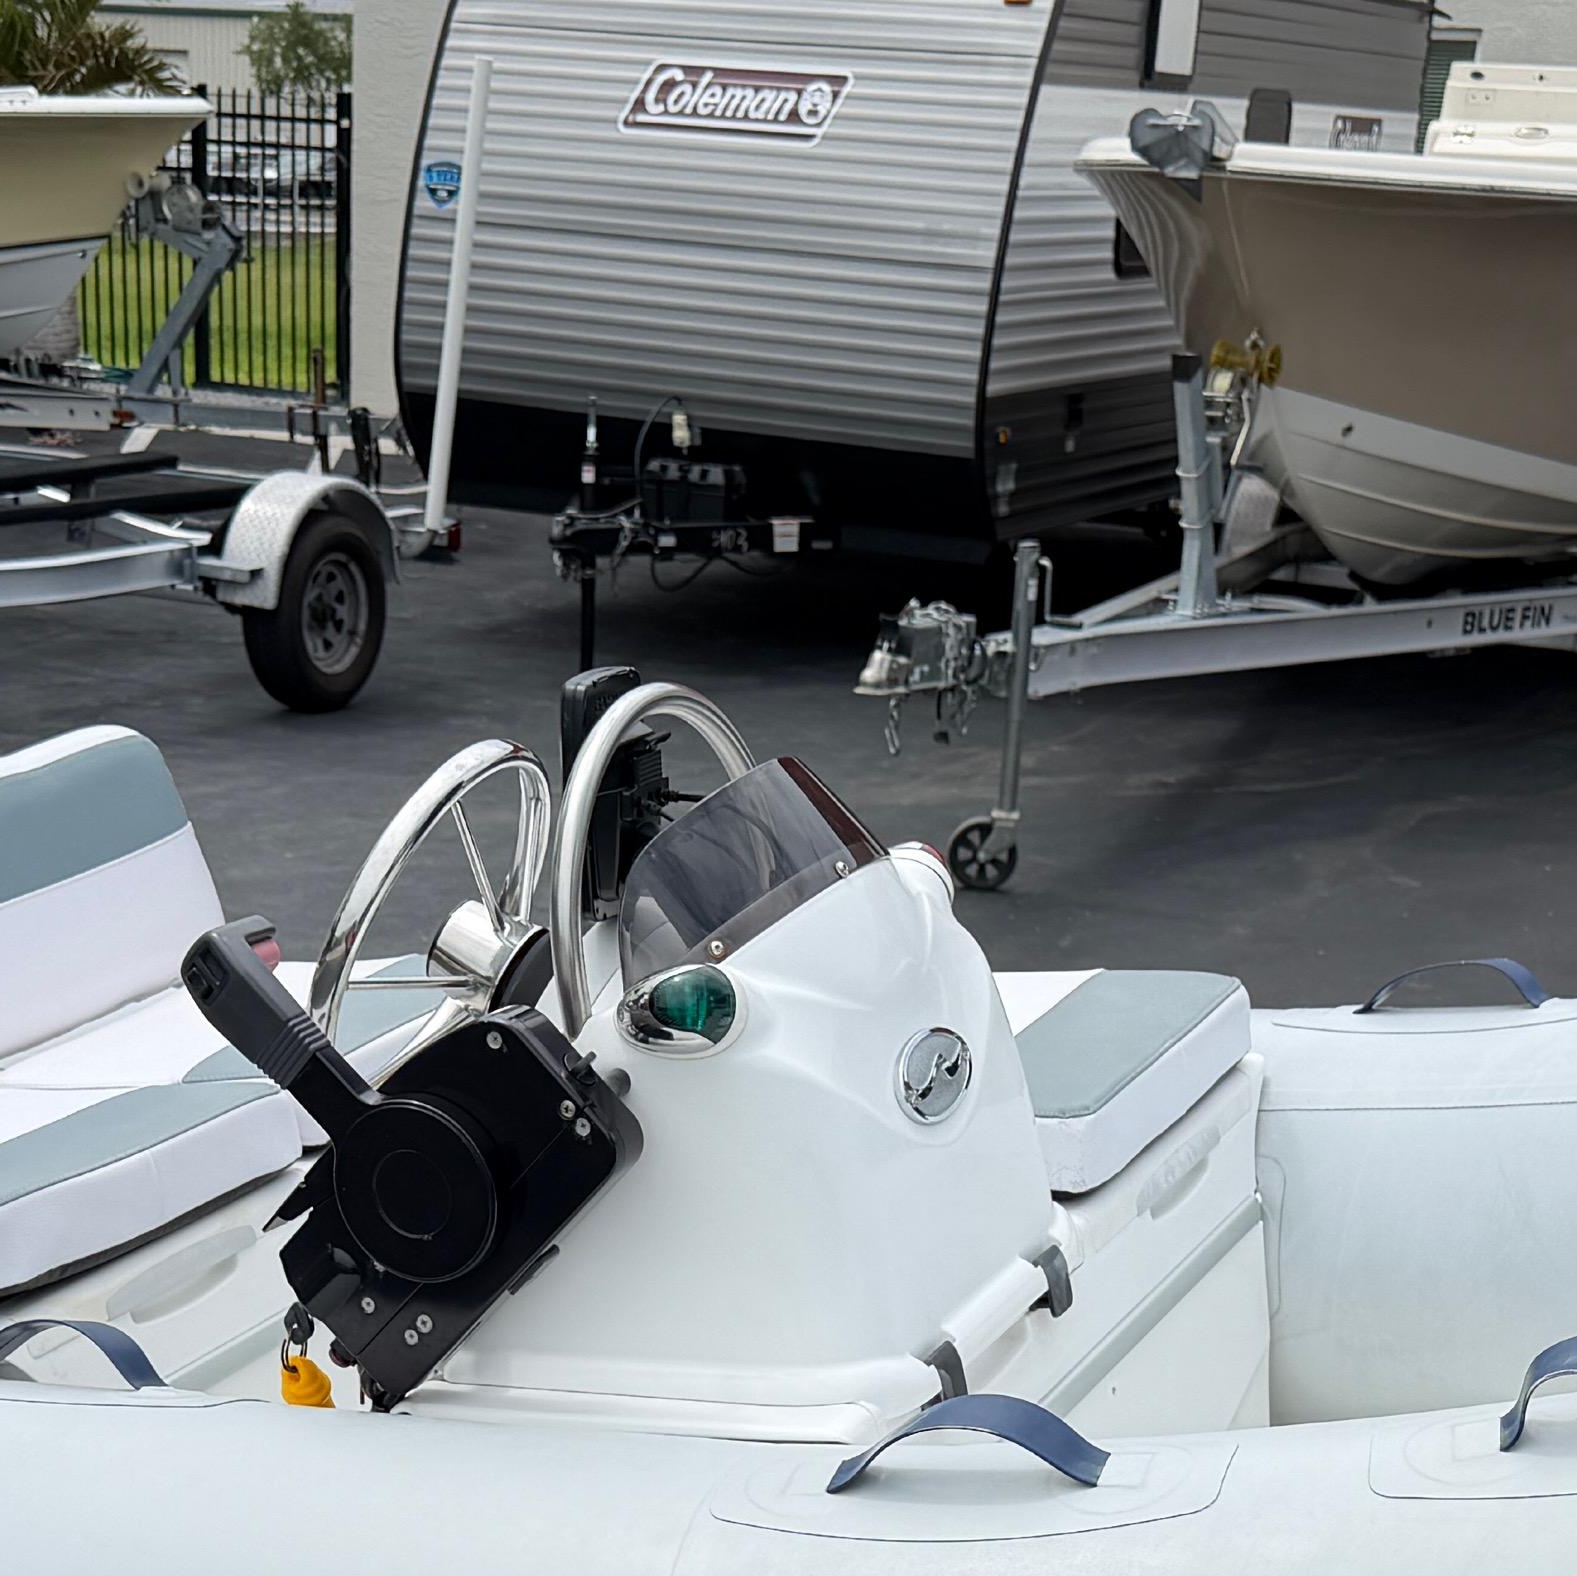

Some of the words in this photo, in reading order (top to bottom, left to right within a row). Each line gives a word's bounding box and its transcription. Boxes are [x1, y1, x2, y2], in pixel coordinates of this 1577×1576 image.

[644, 67, 799, 122] Coleman
[1462, 609, 1516, 637] BLUE
[1518, 604, 1553, 630] FIN
